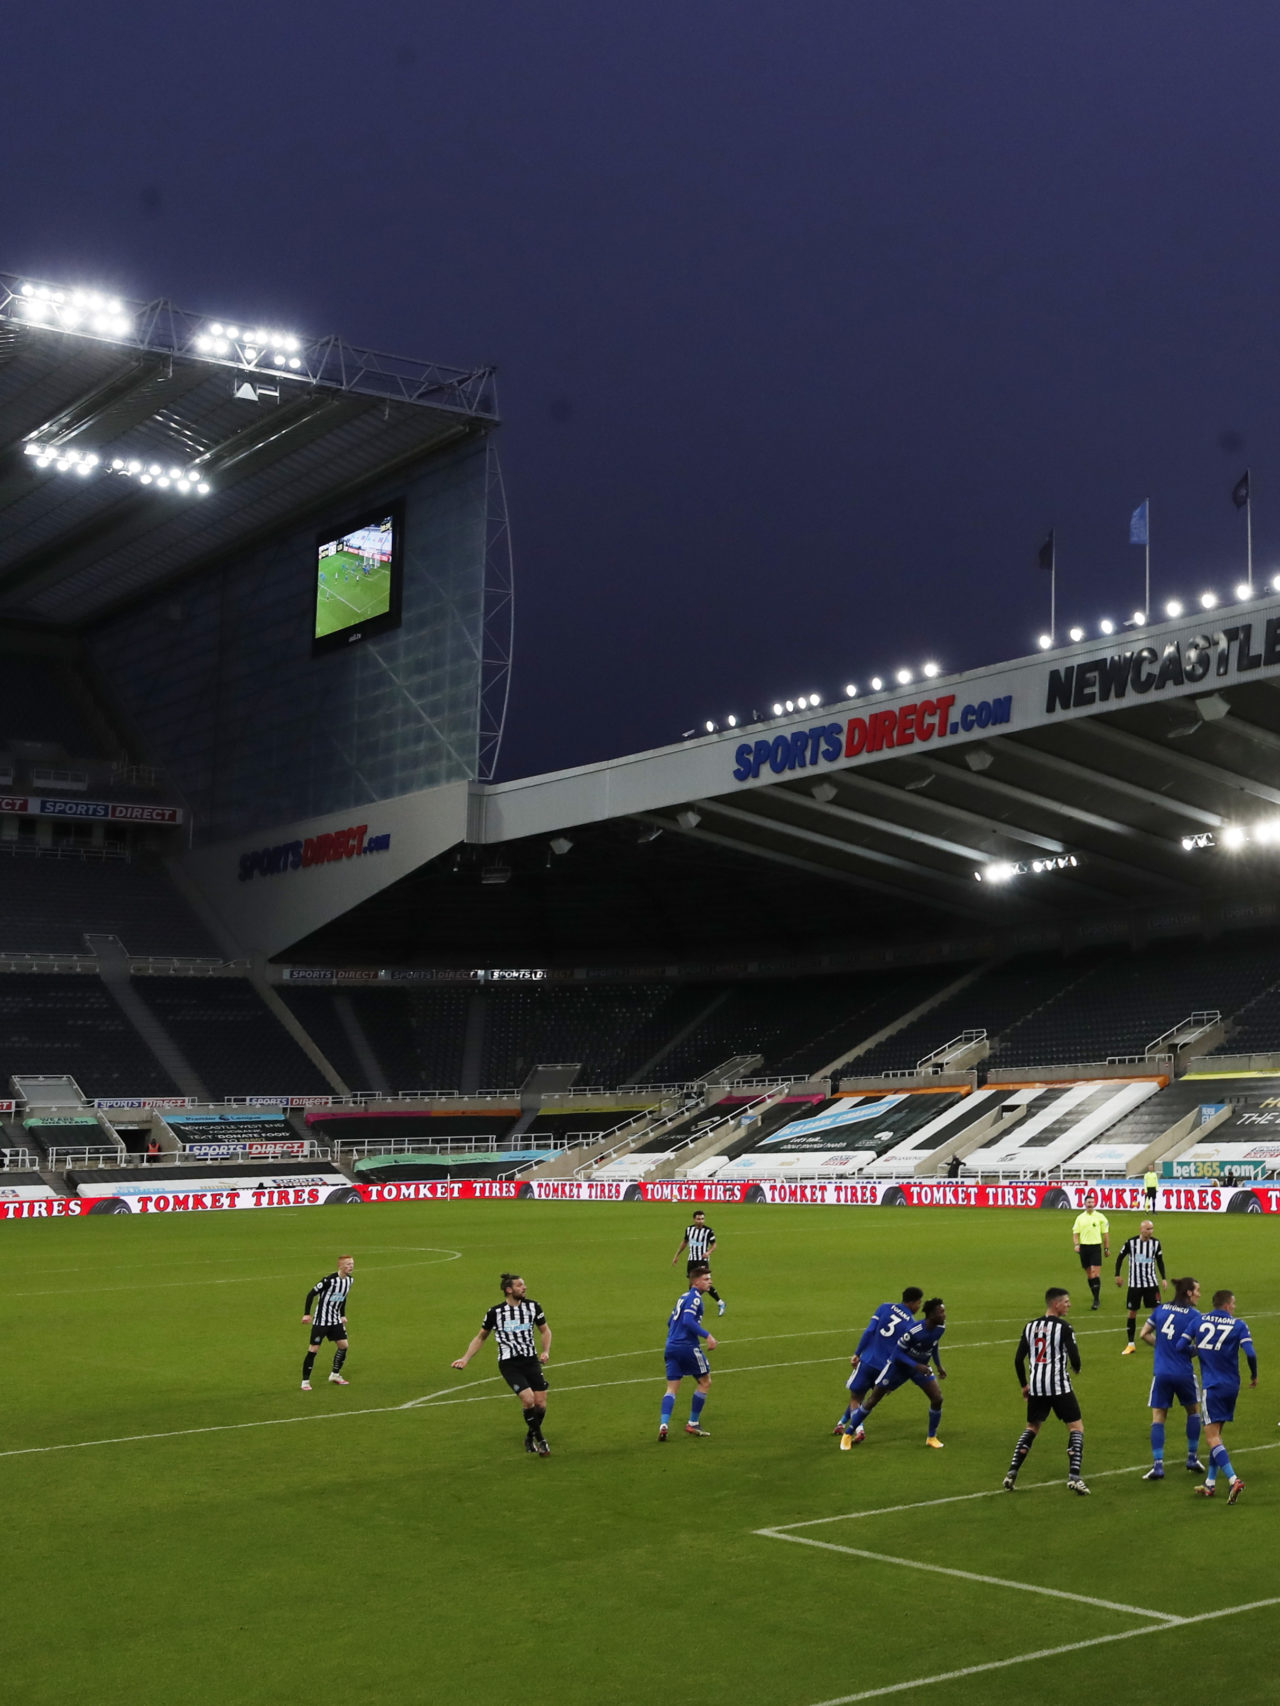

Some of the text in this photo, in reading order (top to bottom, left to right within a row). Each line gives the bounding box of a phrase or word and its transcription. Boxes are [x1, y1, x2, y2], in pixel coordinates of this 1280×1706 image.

[45, 802, 173, 820] SPORTS DIRECT
[292, 970, 332, 978] SPORTS
[292, 1097, 327, 1105] DIRECT
[1237, 1112, 1279, 1125] THE
[192, 1143, 300, 1156] SPORTS DIRECT
[1172, 1161, 1255, 1178] bet365.com
[138, 1189, 320, 1212] TOMKET TIRES
[368, 1182, 516, 1201] TOMKET TIRES
[537, 1183, 621, 1199] TOMKET TIRES
[646, 1184, 697, 1201] TOMKET
[770, 1185, 878, 1204] TOMKET TIRES
[911, 1186, 1037, 1206] TOMKET TIRES
[1163, 1189, 1222, 1211] TIRES
[4, 1199, 82, 1218] TIRES
[880, 1314, 902, 1337] 3
[1161, 1313, 1175, 1340] 4
[1197, 1322, 1234, 1351] 27
[1034, 1337, 1048, 1363] 2
